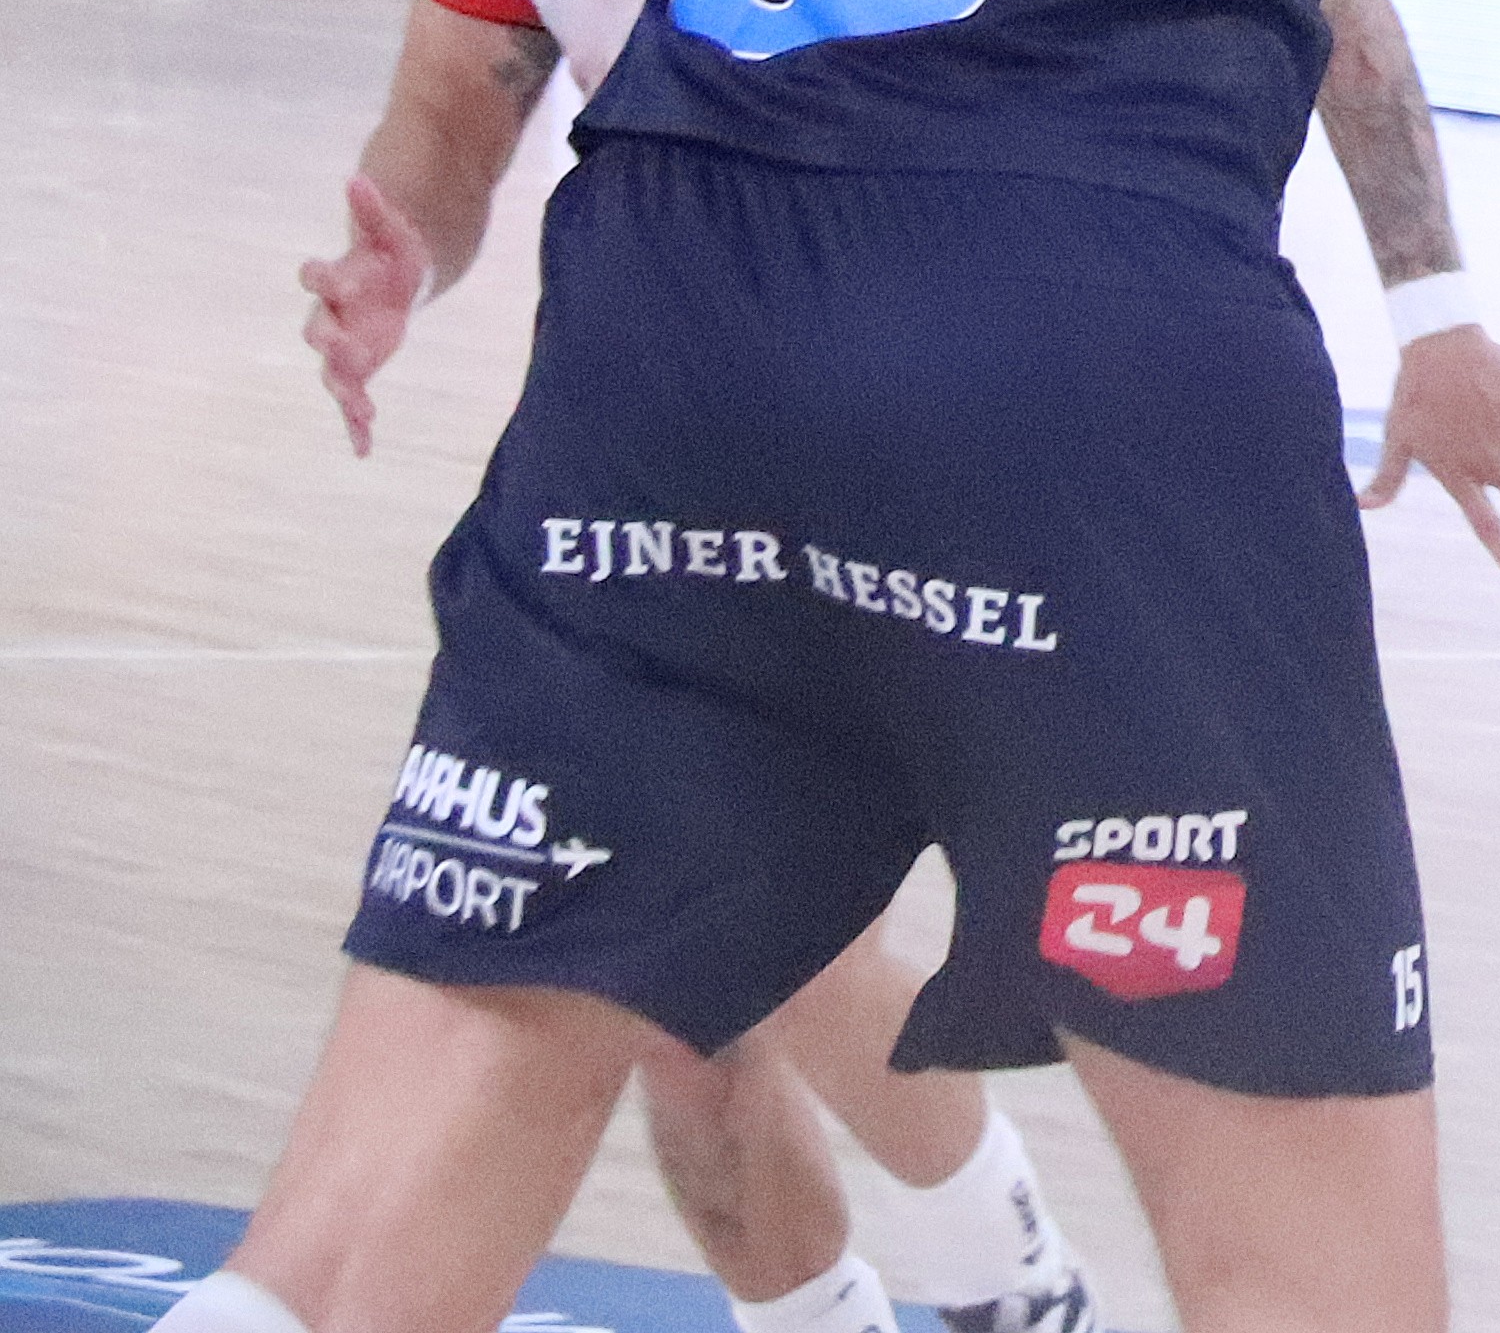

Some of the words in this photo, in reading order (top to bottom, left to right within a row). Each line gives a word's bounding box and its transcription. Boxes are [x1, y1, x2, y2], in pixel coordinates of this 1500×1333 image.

[541, 517, 789, 583] EJNER
[803, 543, 1058, 652] HESSEL
[1053, 809, 1249, 863] SPORT
[1064, 883, 1222, 972] 24
[1391, 943, 1424, 1033] 15
